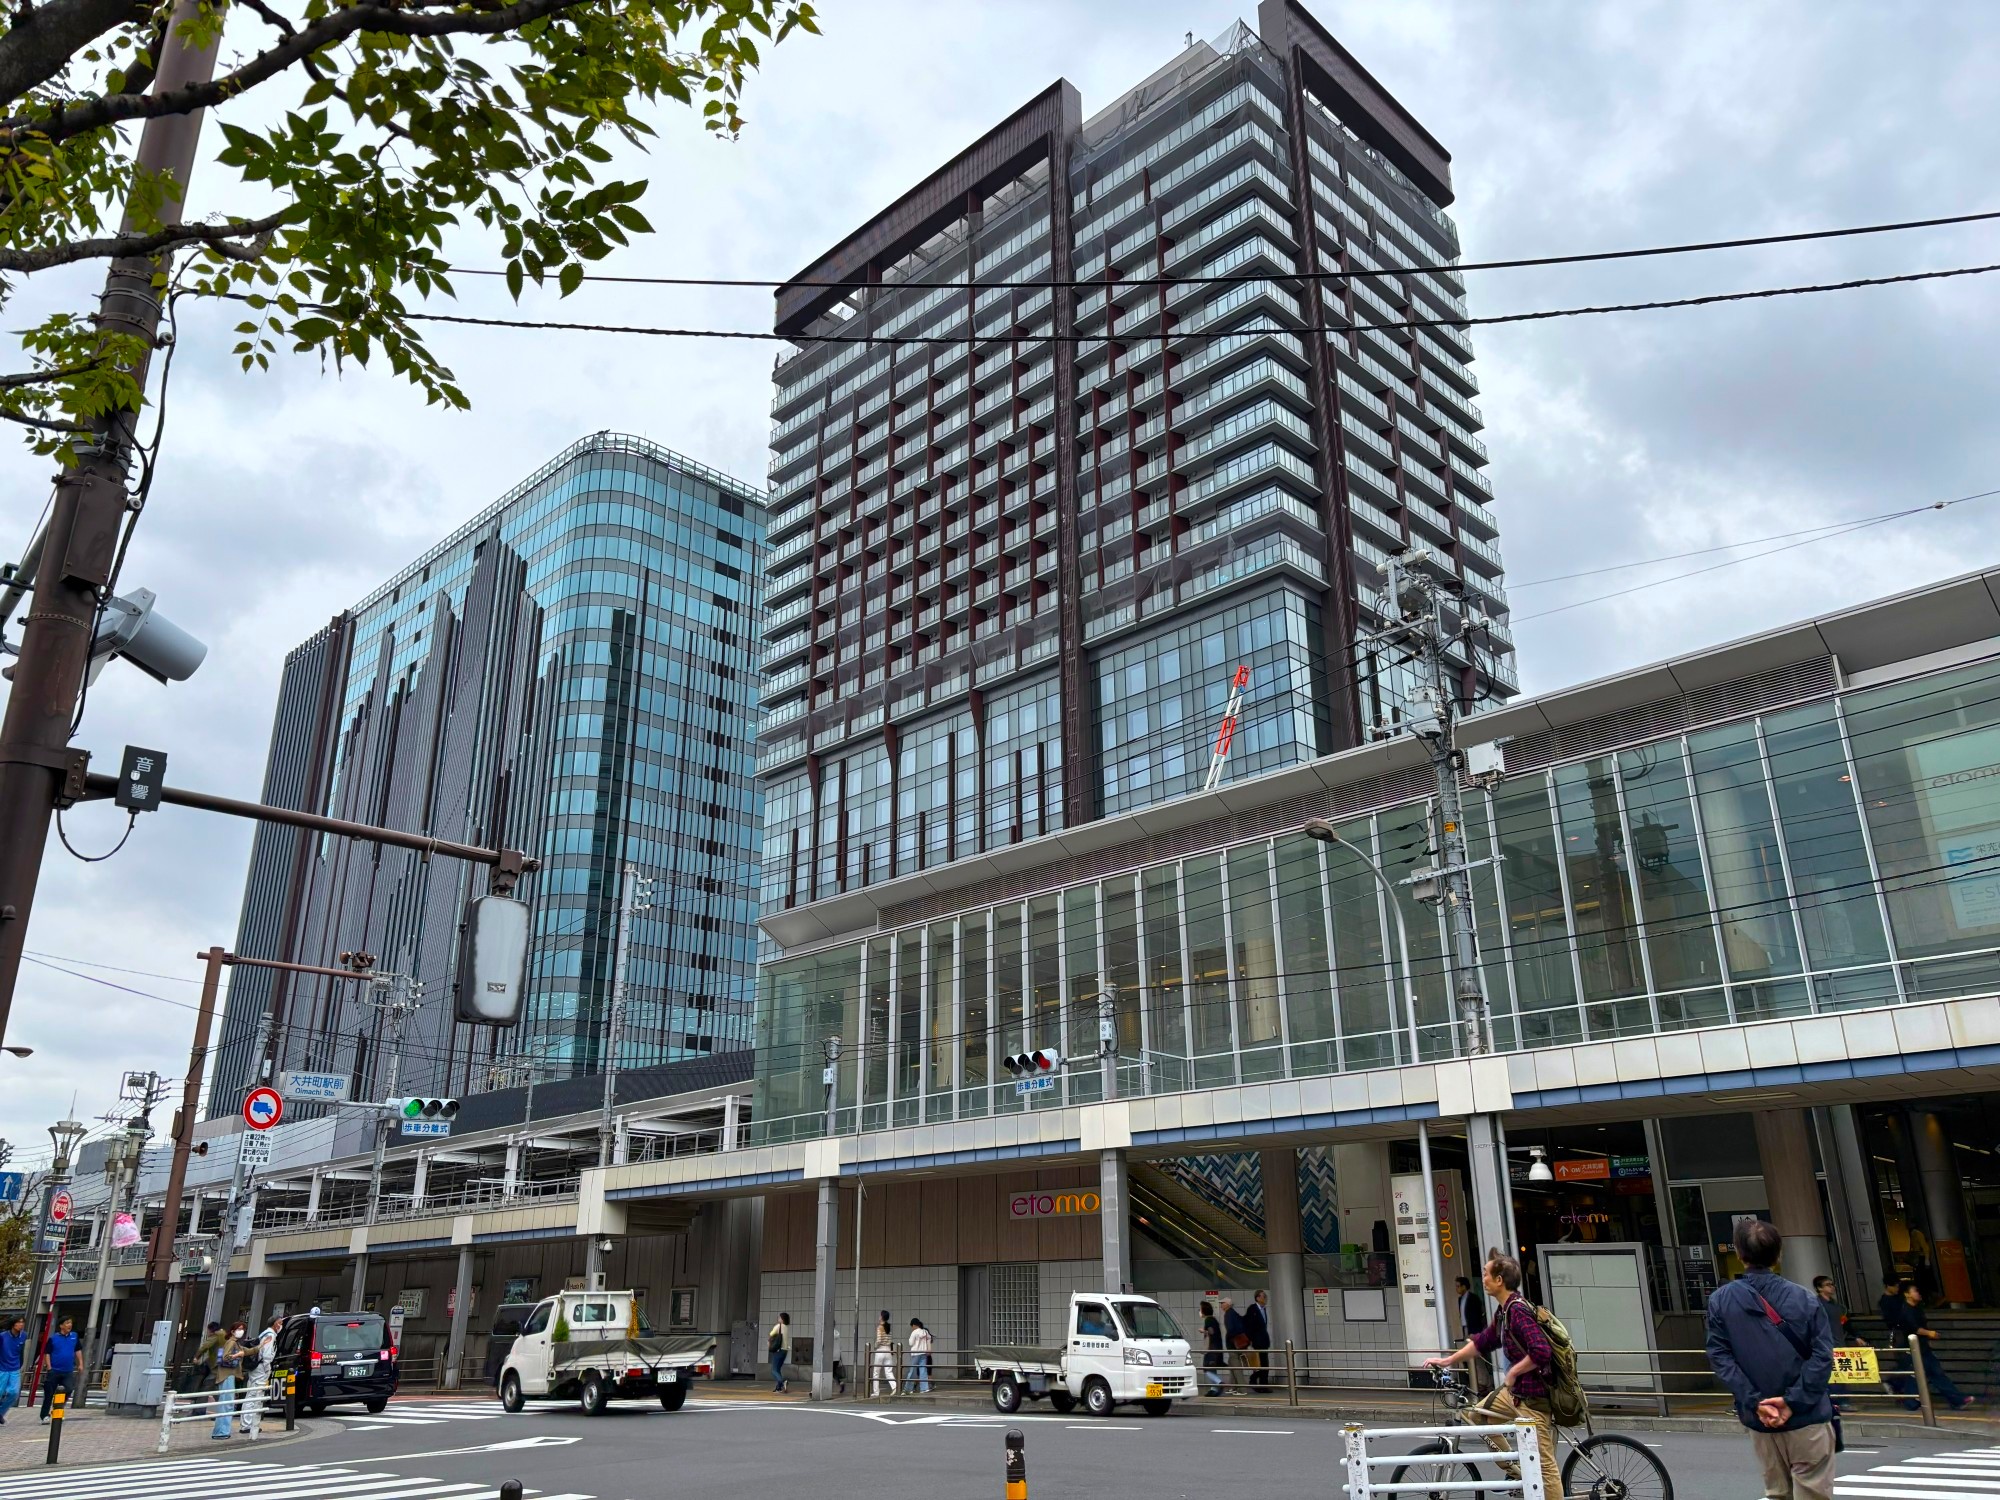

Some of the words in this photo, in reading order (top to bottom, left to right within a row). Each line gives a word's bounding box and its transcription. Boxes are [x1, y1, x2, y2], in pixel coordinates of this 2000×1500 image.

[131, 757, 153, 799] 音響
[290, 1075, 344, 1090] 大井町駅前
[1017, 1076, 1053, 1092] 歩車分離式
[295, 1087, 321, 1096] Oimachi
[323, 1089, 336, 1097] Sta.
[404, 1123, 448, 1133] 歩車分離式
[1011, 1192, 1100, 1216] etomo
[1437, 1184, 1453, 1258] etomo
